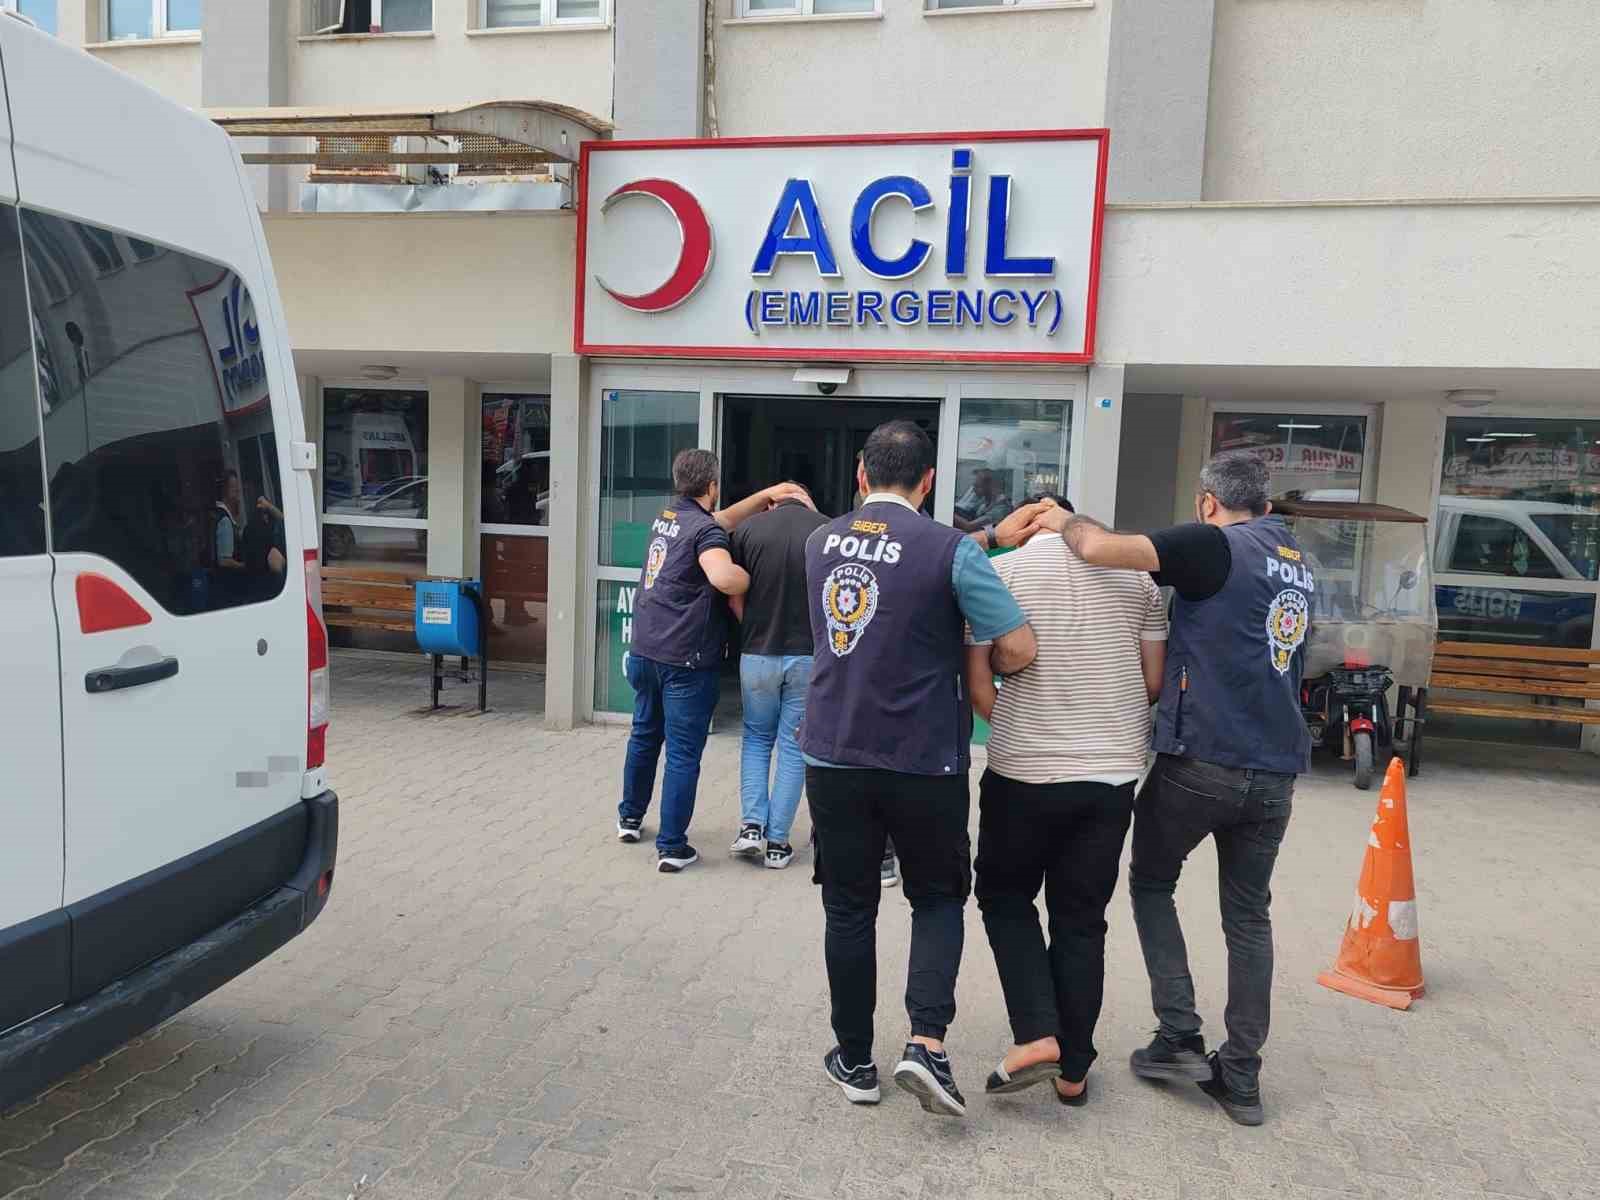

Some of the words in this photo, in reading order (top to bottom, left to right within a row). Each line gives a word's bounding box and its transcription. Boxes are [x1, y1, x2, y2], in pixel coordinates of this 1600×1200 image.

[751, 148, 1055, 278] ACİL
[745, 289, 1064, 335] (EMERGENCY)
[652, 518, 680, 538] POLİS
[823, 534, 903, 565] POLİS
[1266, 557, 1314, 592] POLİS
[616, 586, 636, 614] AY
